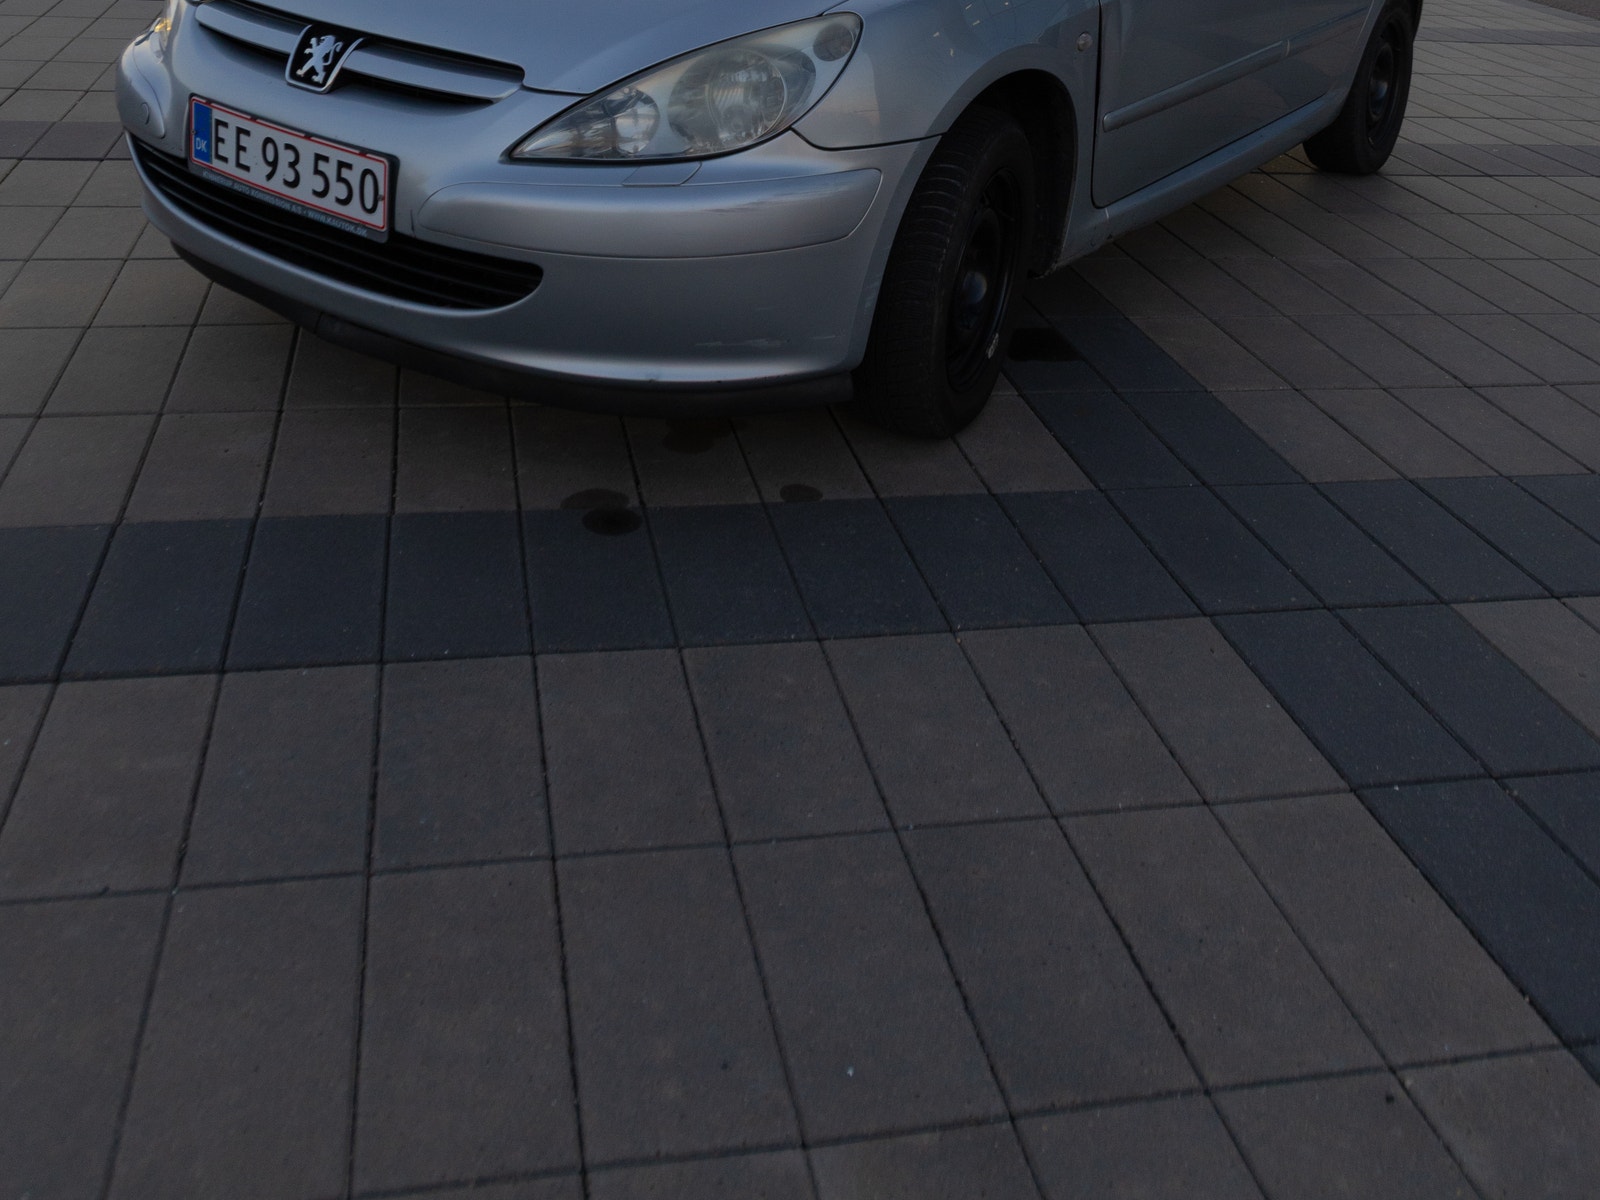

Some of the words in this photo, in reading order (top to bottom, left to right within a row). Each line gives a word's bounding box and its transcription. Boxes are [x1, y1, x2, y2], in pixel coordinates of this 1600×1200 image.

[195, 137, 207, 153] DK
[214, 118, 251, 173] EE
[261, 136, 300, 189] 93
[311, 152, 379, 215] 550
